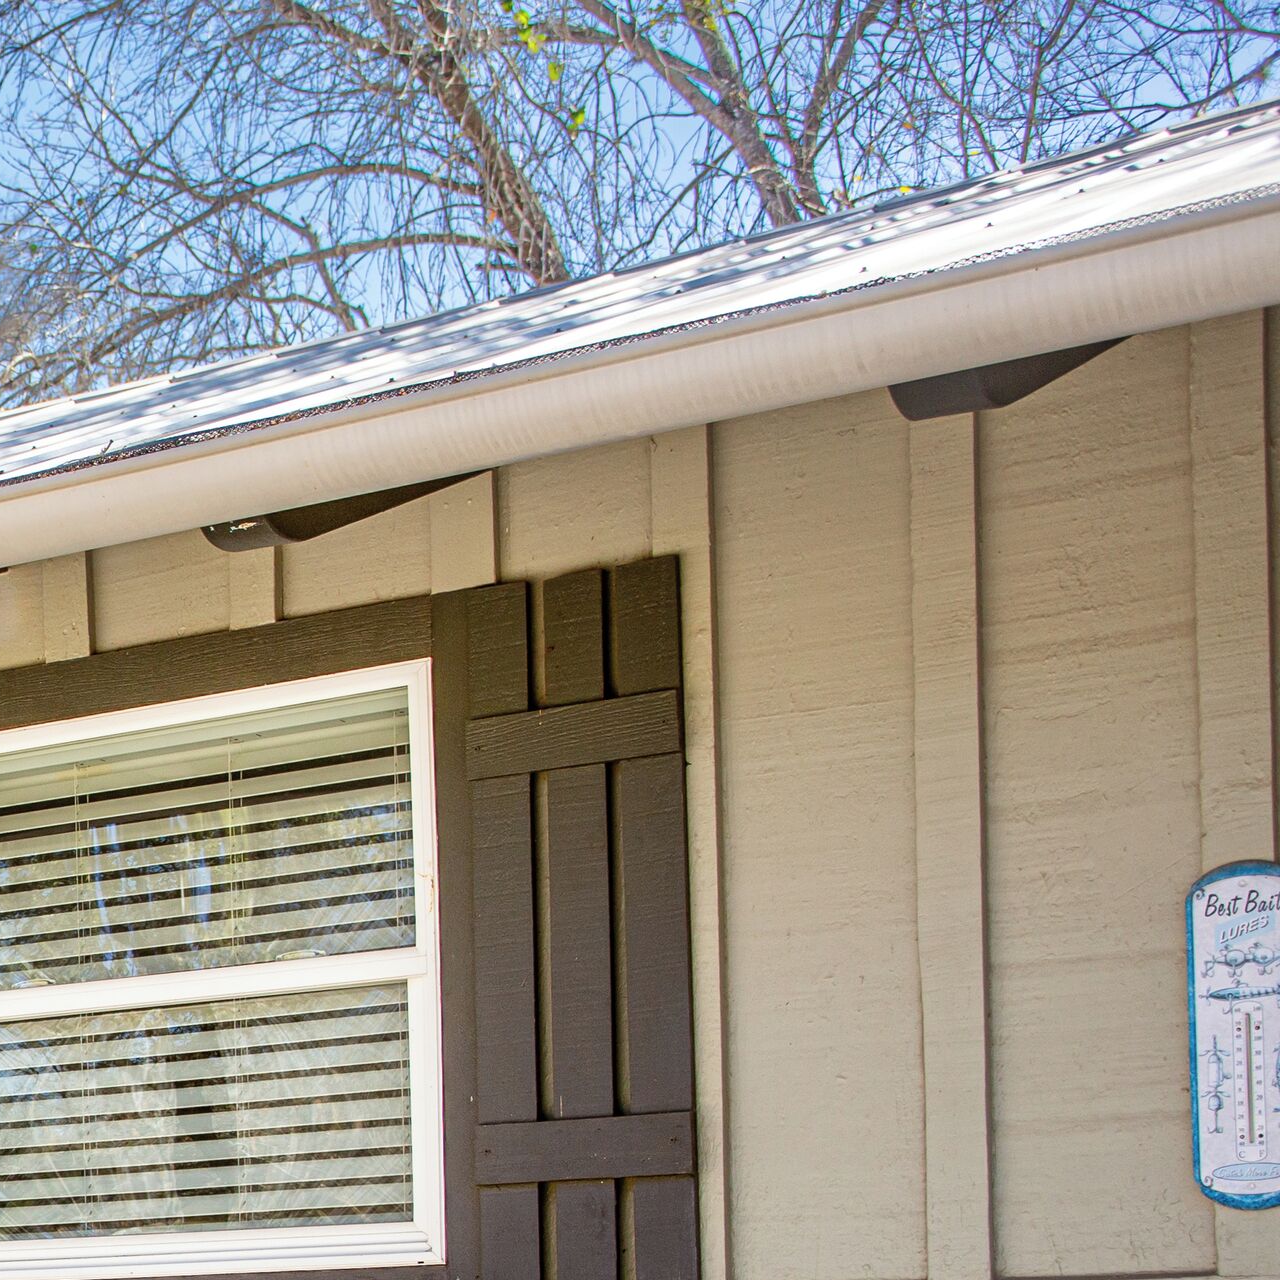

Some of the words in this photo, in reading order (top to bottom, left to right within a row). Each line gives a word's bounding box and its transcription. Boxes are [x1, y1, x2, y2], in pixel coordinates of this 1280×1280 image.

[1204, 893, 1243, 917] Best
[1244, 889, 1280, 914] Bait
[1221, 915, 1269, 944] LURES
